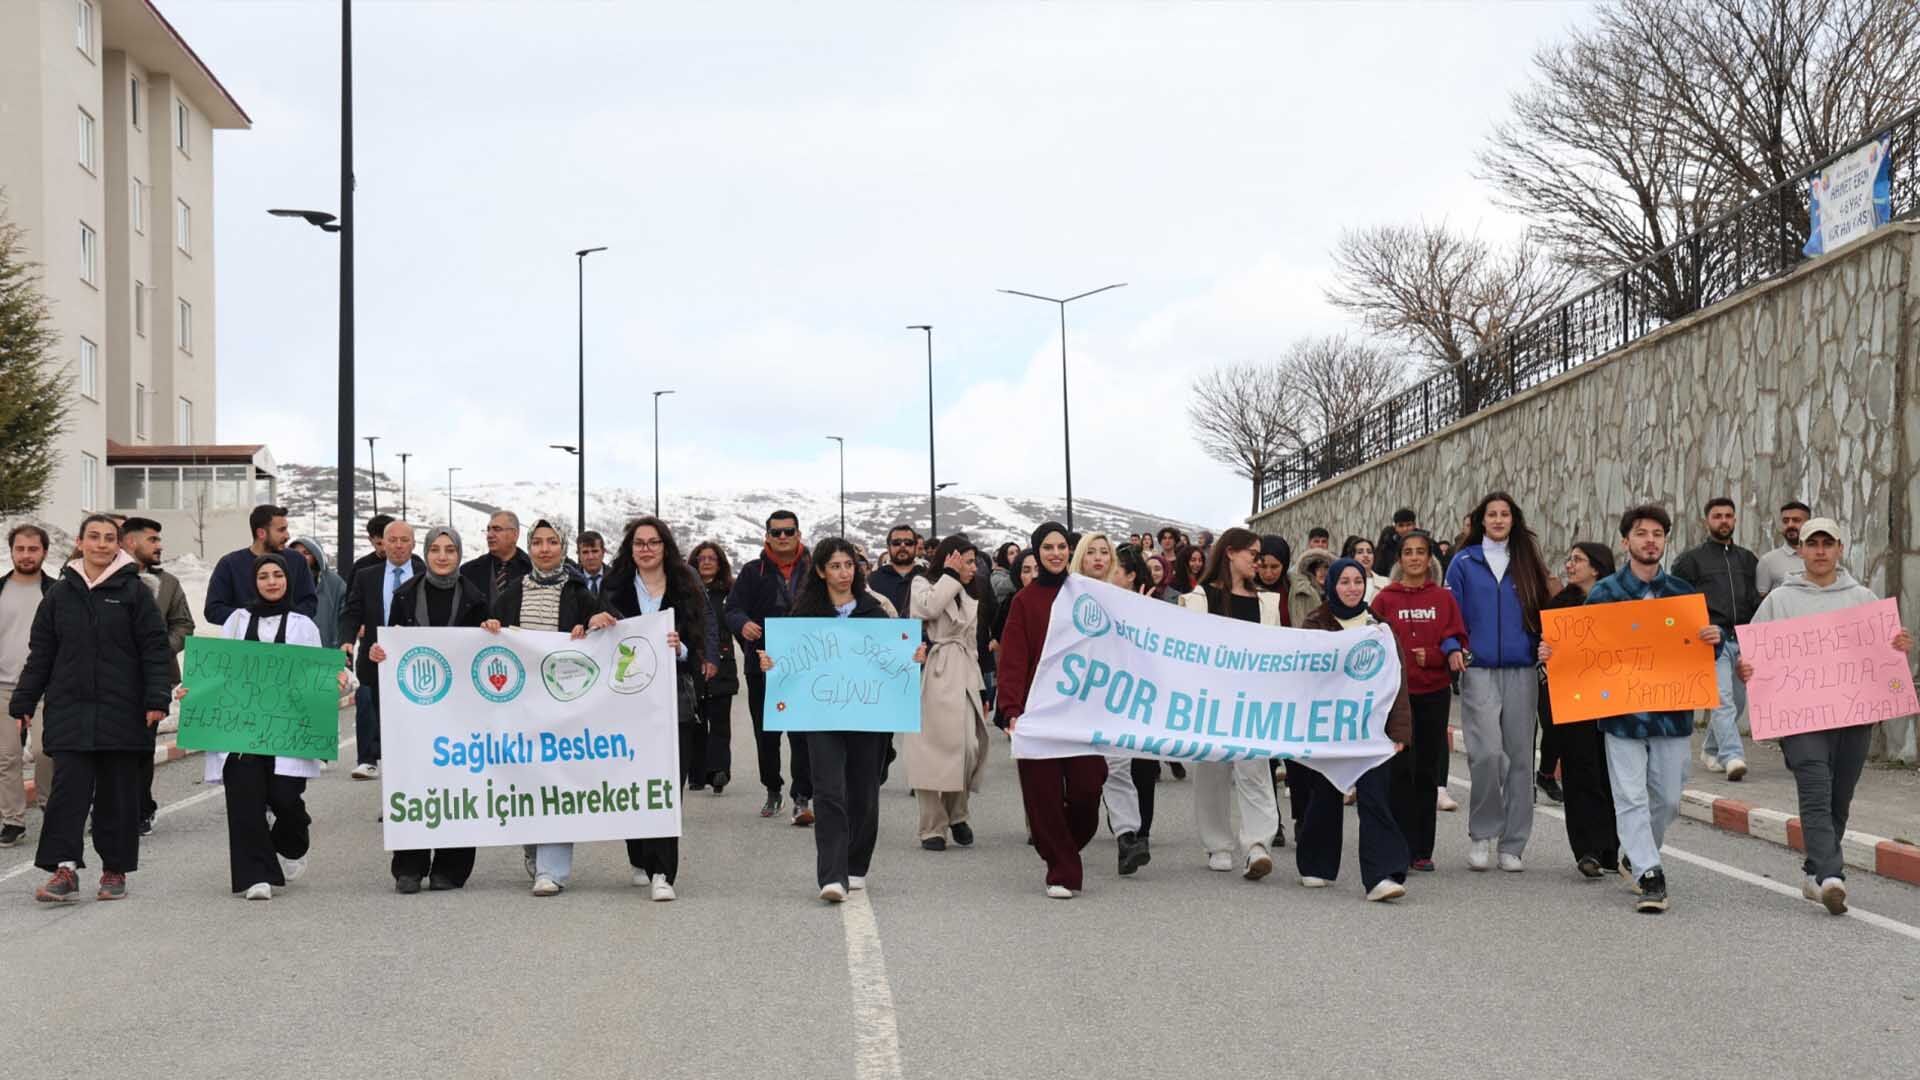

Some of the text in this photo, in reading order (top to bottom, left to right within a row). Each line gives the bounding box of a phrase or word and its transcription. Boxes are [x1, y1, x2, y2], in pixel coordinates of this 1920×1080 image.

[1398, 606, 1436, 620] mavi
[1550, 615, 1600, 648] SPOR
[774, 628, 841, 688] DÜNYA
[1115, 618, 1160, 653] BİTLİS
[1162, 637, 1211, 665] EREN
[1215, 644, 1339, 673] ÜNİVERSİTESİ
[218, 679, 307, 715] SPOR
[1776, 657, 1877, 693] KALMA
[1056, 652, 1375, 744] SPOR BİLİMLERİ
[1753, 689, 1919, 734] HAYATI YAKALA
[433, 728, 635, 774] Sağlıklı Beslen,
[389, 778, 674, 829] Sağlık İçin Hareket Et
